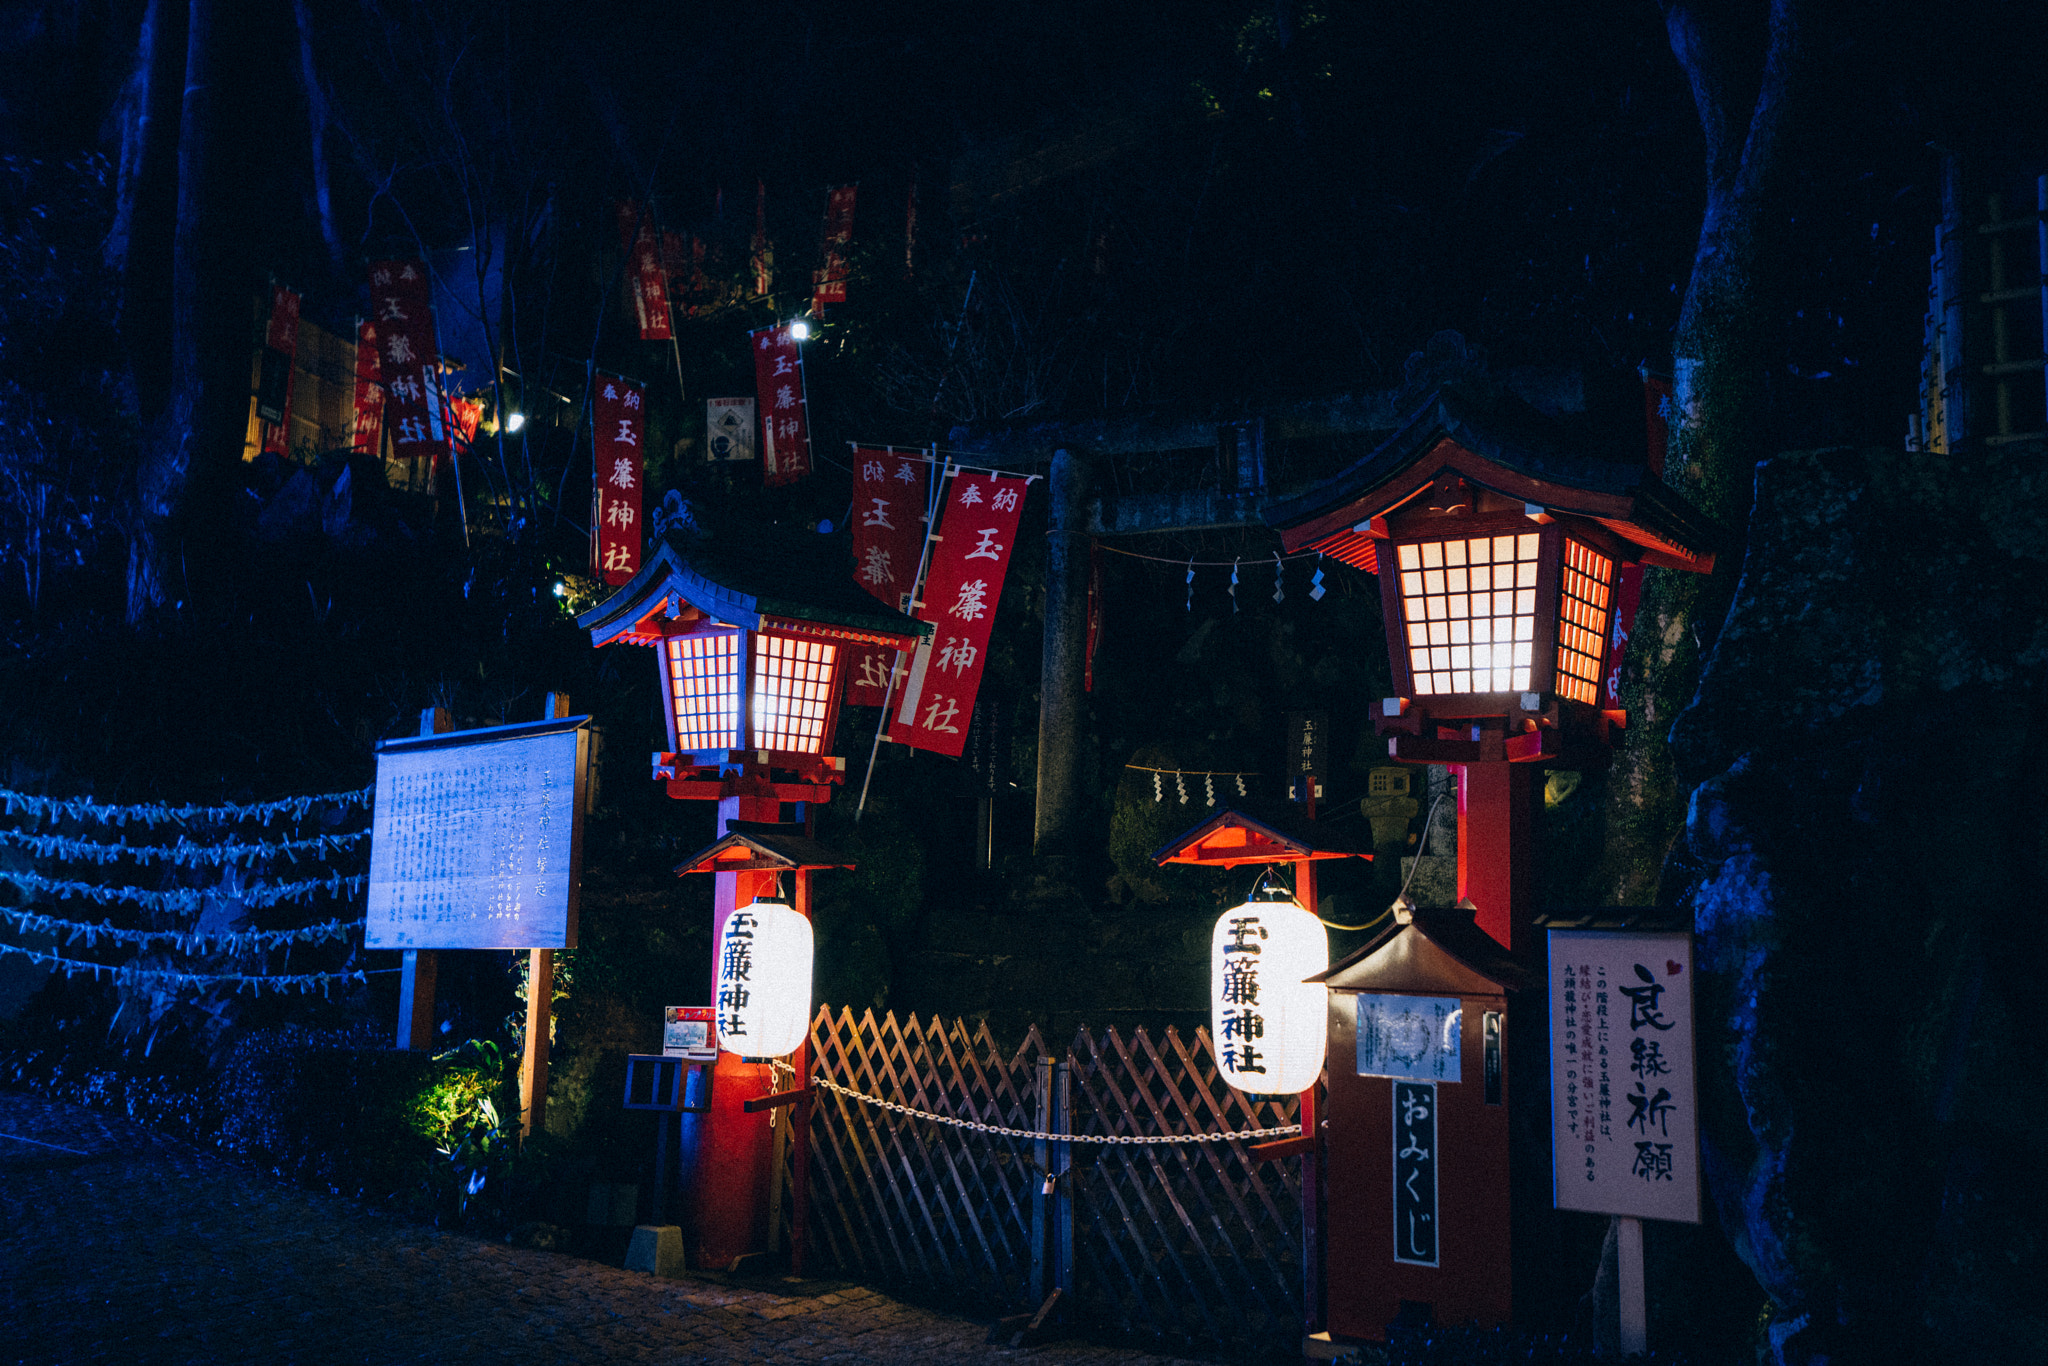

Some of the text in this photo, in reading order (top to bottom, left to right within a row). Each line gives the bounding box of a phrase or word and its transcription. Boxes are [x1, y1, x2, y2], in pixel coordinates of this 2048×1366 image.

[603, 383, 640, 411] 奉納
[603, 419, 637, 573] 玉簾神社
[959, 483, 1018, 513] 奉納
[923, 528, 1004, 734] 玉簾神社
[718, 913, 758, 1038] 玉簾神社
[1220, 917, 1268, 1075] 玉簾神社
[1619, 963, 1677, 1182] 良縁祈願
[1400, 1089, 1430, 1256] おみくじ
